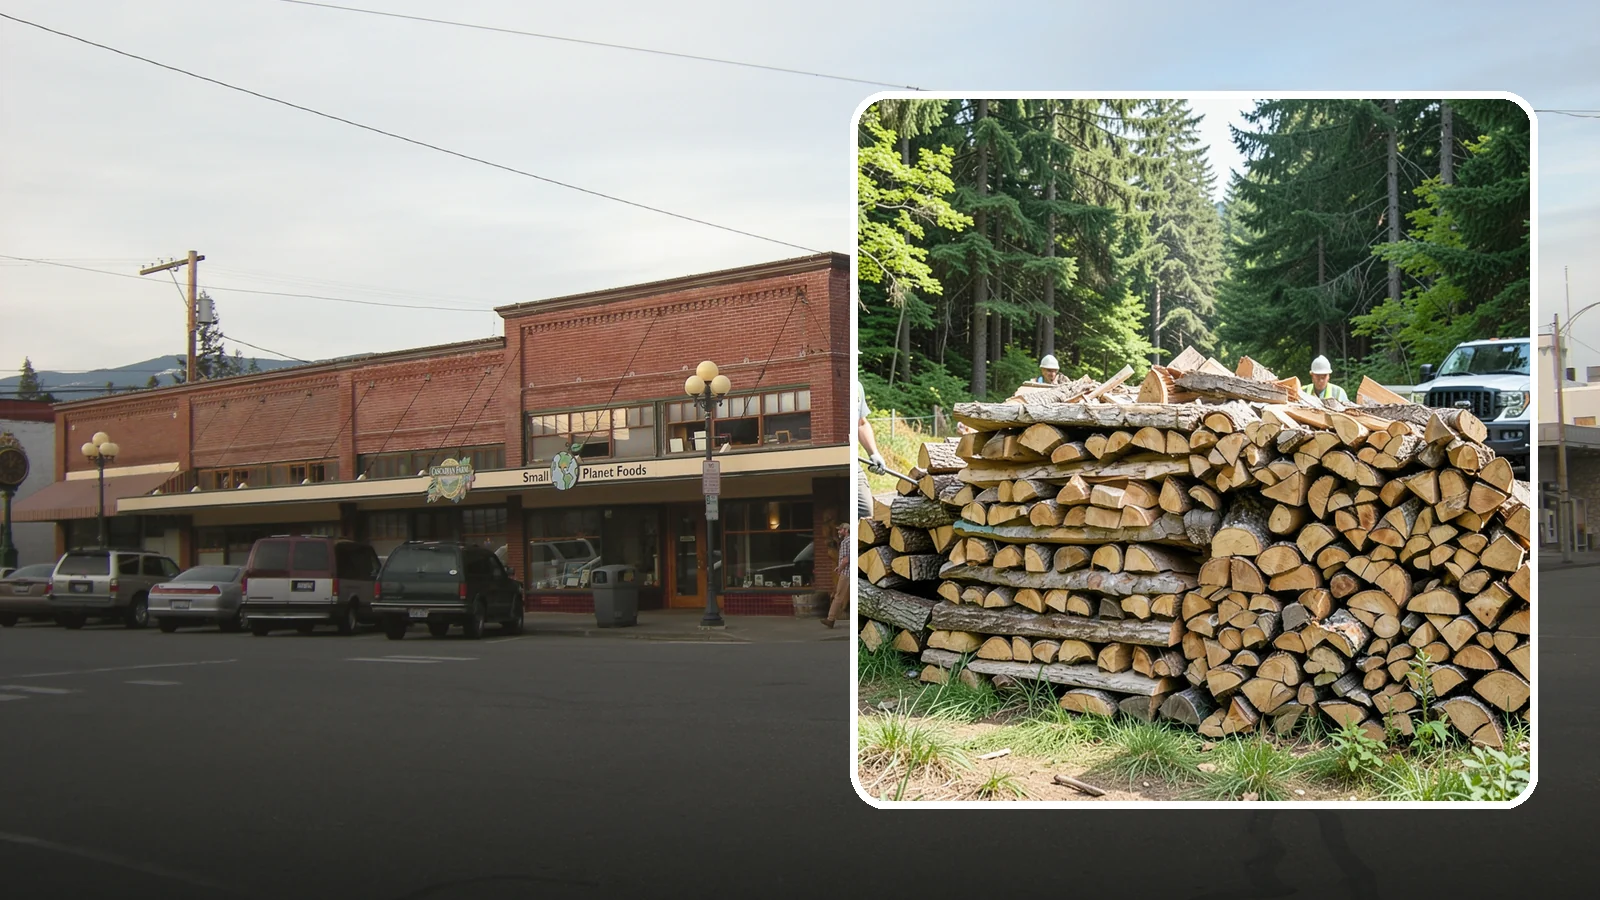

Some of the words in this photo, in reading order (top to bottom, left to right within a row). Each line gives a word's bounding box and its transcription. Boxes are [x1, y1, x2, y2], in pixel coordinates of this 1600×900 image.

[523, 471, 549, 483] Small
[583, 467, 614, 479] Planet
[617, 464, 647, 477] Foods
